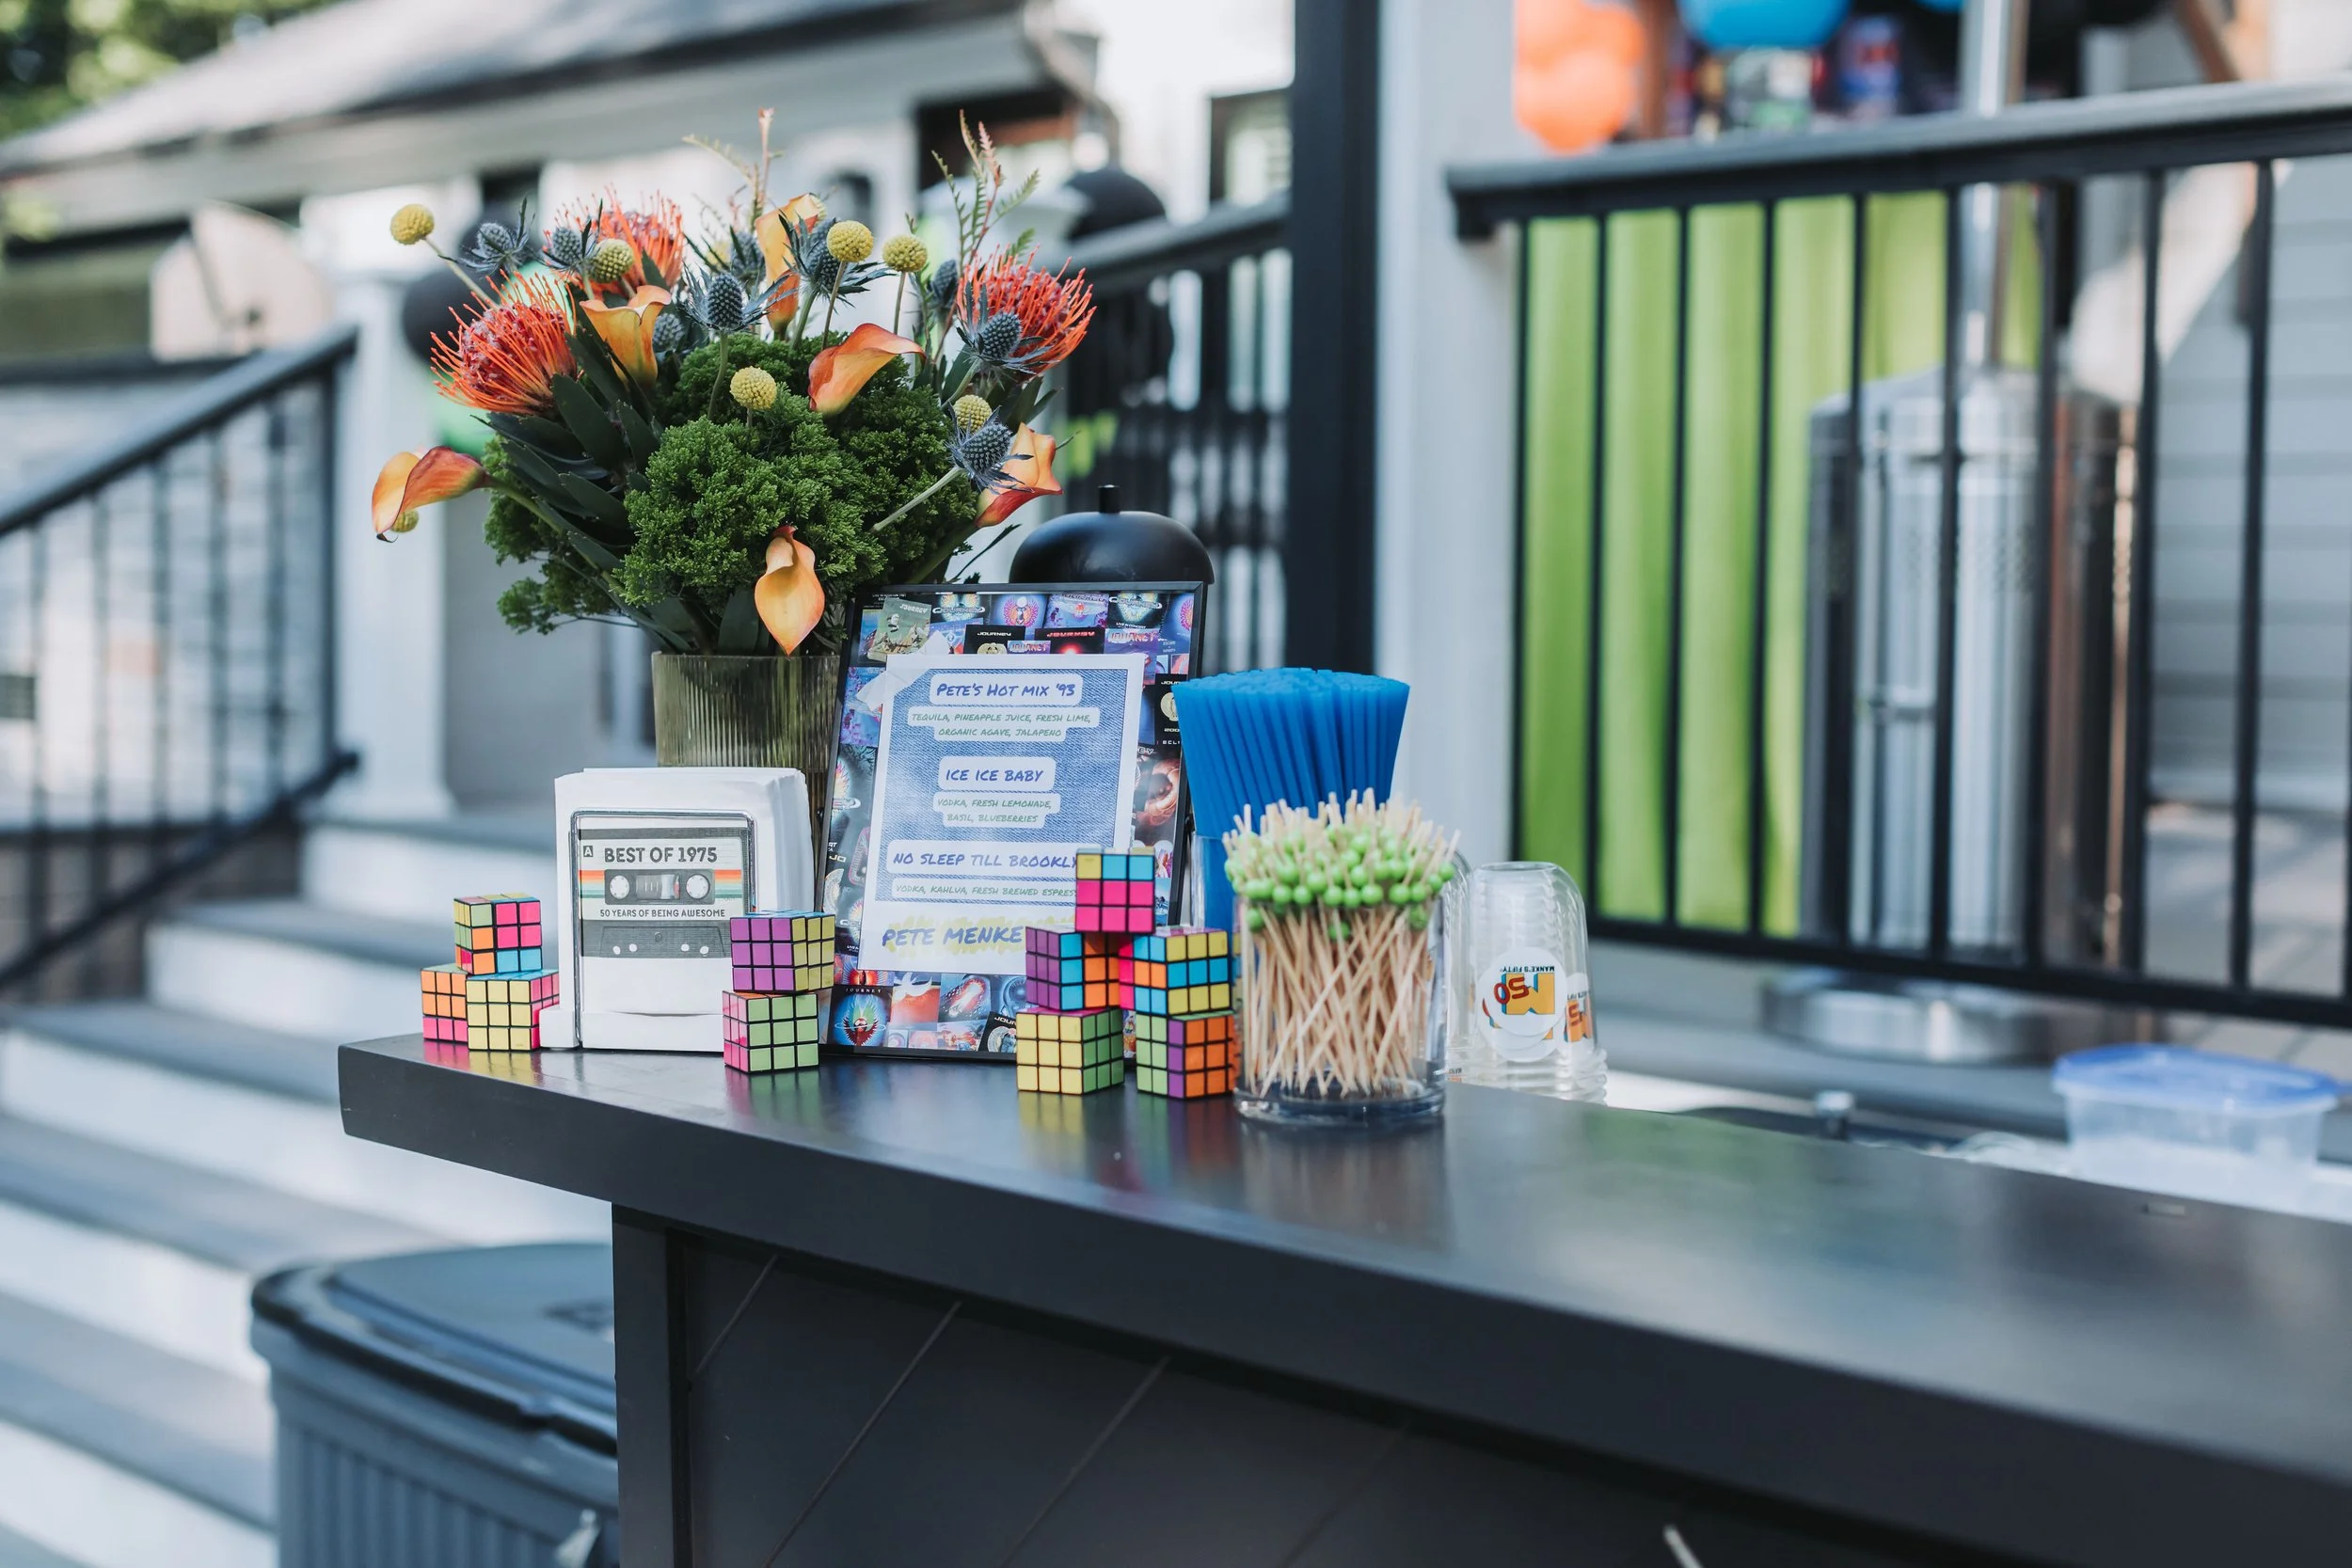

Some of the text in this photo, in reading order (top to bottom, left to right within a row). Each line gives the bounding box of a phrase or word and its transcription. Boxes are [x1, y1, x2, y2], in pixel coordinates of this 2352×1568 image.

[987, 683, 1018, 697] HOT
[912, 713, 1091, 724] TEQUILA, PINEAPPLE JUICE, FRESH LIME,
[938, 728, 1062, 737] ORGANIC AGAVE, JALAPENO
[946, 768, 1043, 783] ICE ICE BABY
[937, 799, 1052, 810] VODKA, FRESH LEMONADE,
[947, 814, 1039, 823] BASIL, BLUEBERRIES
[583, 846, 593, 857] A
[604, 847, 718, 863] BEST OF 1975
[893, 852, 1076, 868] NO SLEEP TILL BROOKLY
[897, 885, 1076, 897] VODKA, KAHLUA, FRESH BREWED ESPRES
[600, 909, 725, 917] 50 YEARS OF BEING AWESOME
[882, 926, 1024, 947] PETE MENKE
